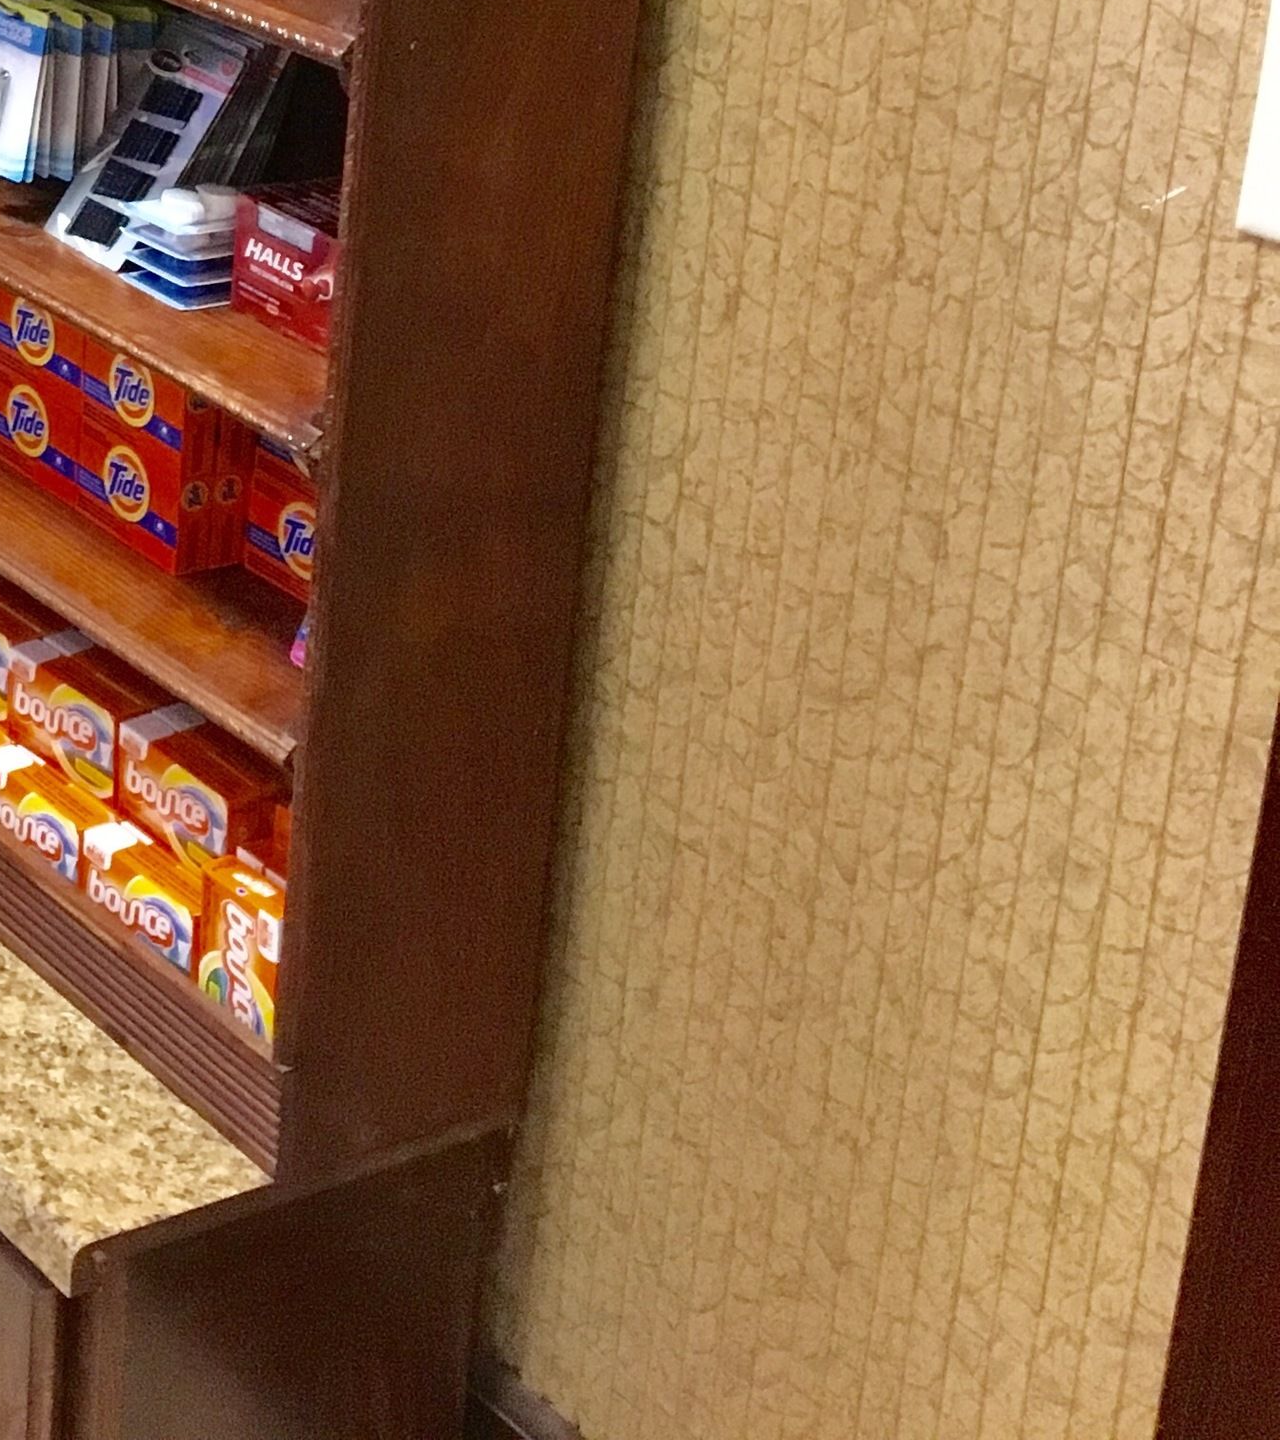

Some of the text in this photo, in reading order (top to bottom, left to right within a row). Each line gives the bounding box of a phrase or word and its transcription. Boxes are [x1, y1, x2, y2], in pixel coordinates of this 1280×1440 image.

[244, 238, 306, 282] HALLS
[15, 309, 50, 344] Tide
[114, 367, 150, 406] Tide
[11, 400, 45, 437] Tide
[107, 461, 145, 503] Tide
[282, 522, 313, 556] Tid
[14, 682, 93, 743] bounce
[123, 760, 206, 830] bounce
[87, 870, 171, 940] bounce
